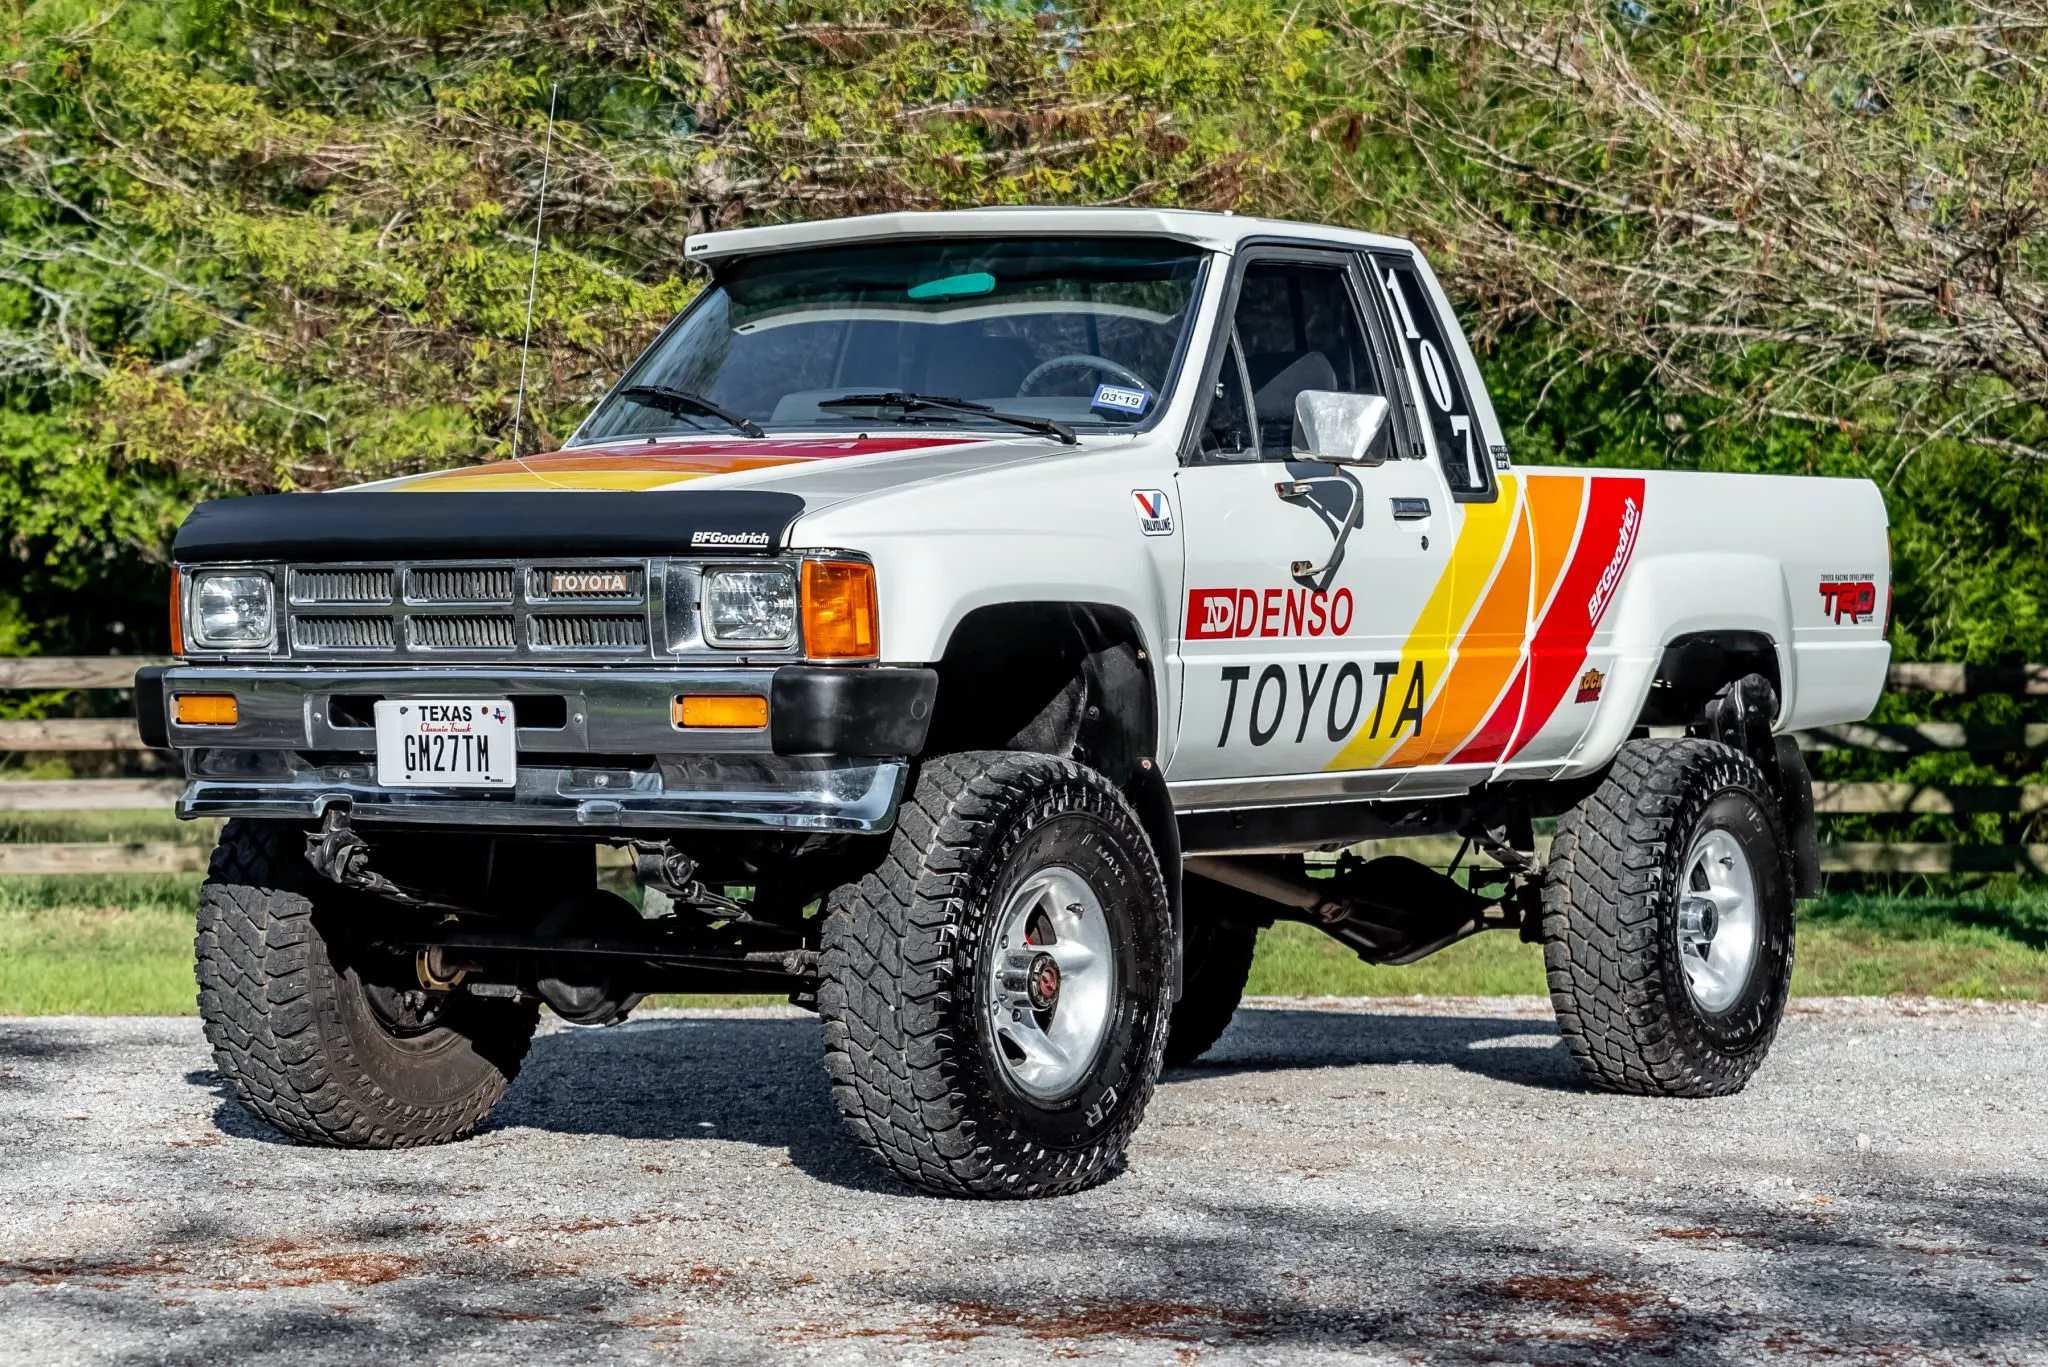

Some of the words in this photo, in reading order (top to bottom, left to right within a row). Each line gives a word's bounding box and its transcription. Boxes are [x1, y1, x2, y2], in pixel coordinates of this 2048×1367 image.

[691, 531, 769, 545] BFGoodrich
[1141, 517, 1171, 532] VALVOLINE
[1588, 497, 1637, 620] BFGoodrich
[555, 575, 625, 591] TOYOTA
[1235, 587, 1354, 638] DENSO
[1819, 582, 1876, 625] TRD
[418, 705, 472, 722] TEXAS
[1217, 661, 1424, 748] TOYOTA
[404, 734, 490, 772] GM27TM
